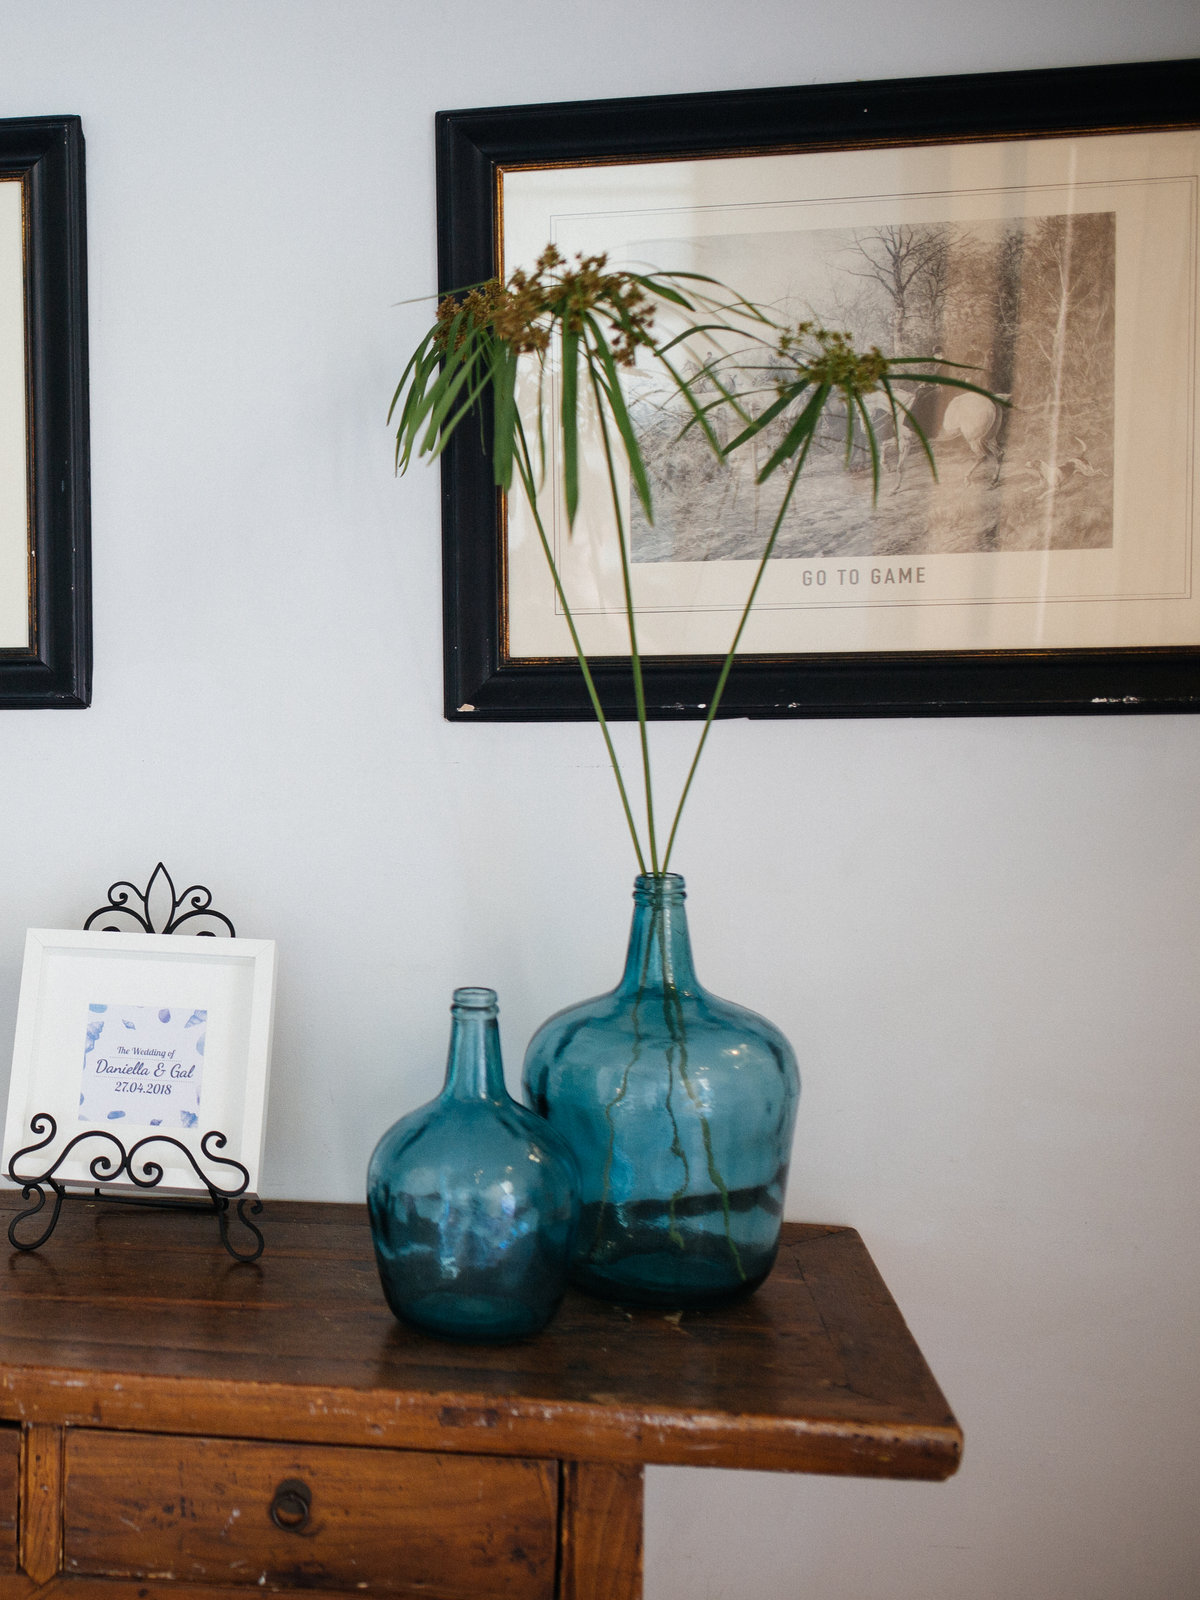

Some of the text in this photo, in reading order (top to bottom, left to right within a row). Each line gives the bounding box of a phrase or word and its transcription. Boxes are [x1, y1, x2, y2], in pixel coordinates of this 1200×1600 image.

[802, 567, 925, 586] GO TO GAME
[117, 1046, 176, 1059] The Wedding of
[96, 1059, 196, 1079] Daniella & Gal
[115, 1082, 172, 1095] 27.04.2018
